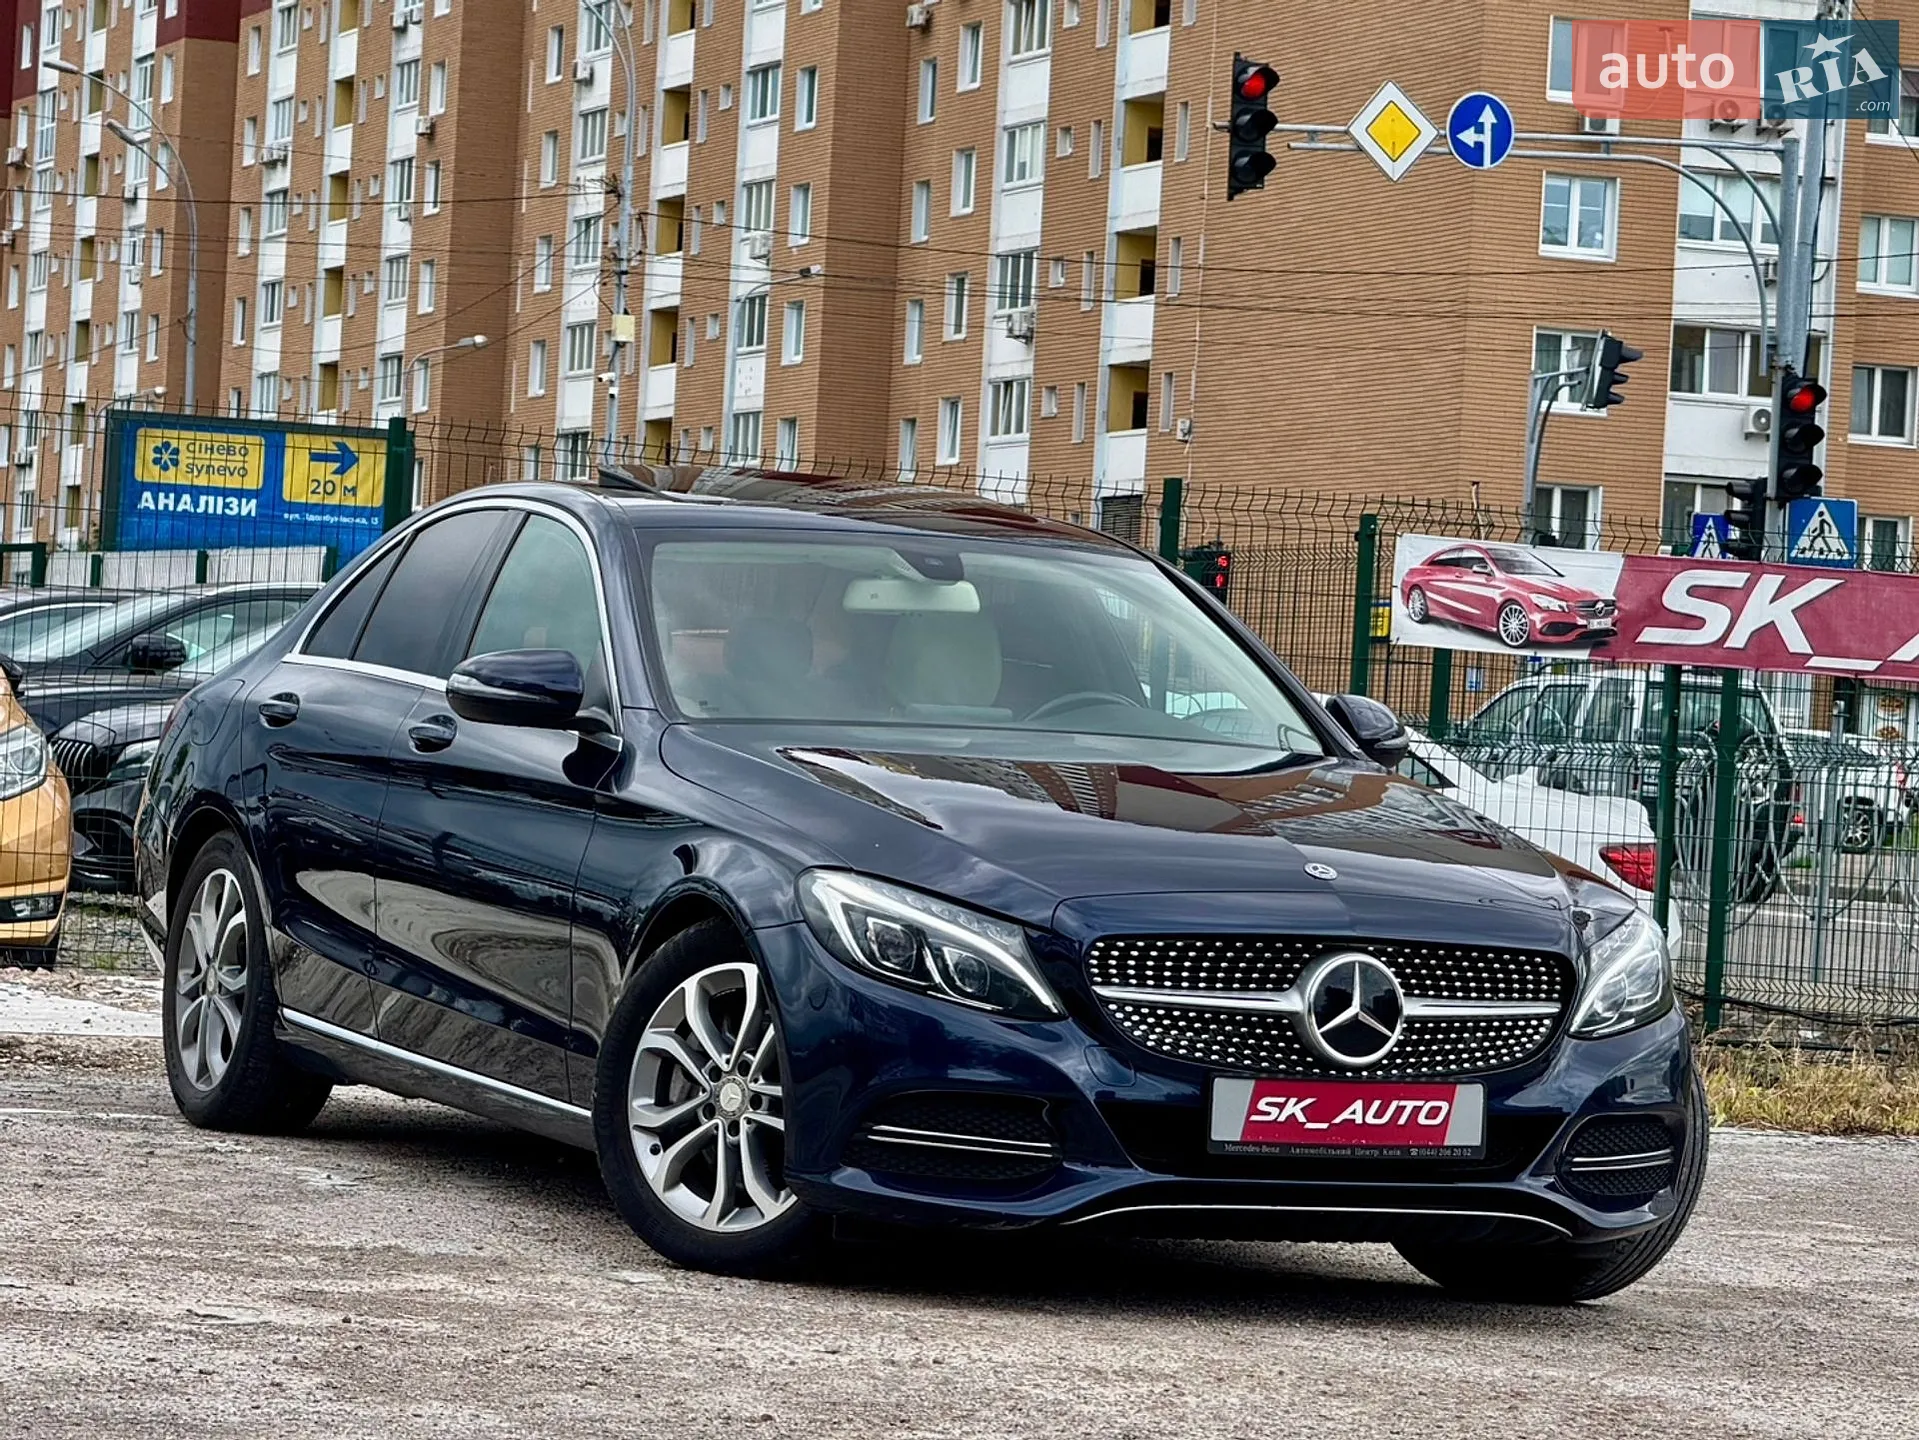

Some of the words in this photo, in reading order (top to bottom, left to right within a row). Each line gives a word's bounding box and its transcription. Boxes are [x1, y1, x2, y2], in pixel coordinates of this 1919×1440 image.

[185, 462, 248, 478] synevo
[310, 479, 336, 496] 20
[138, 491, 258, 517] АНАЛІЗИ
[1635, 569, 1919, 672] SK_
[1249, 1096, 1451, 1129] SK_AUTO
[1224, 1143, 1280, 1154] Mercedes-Benz
